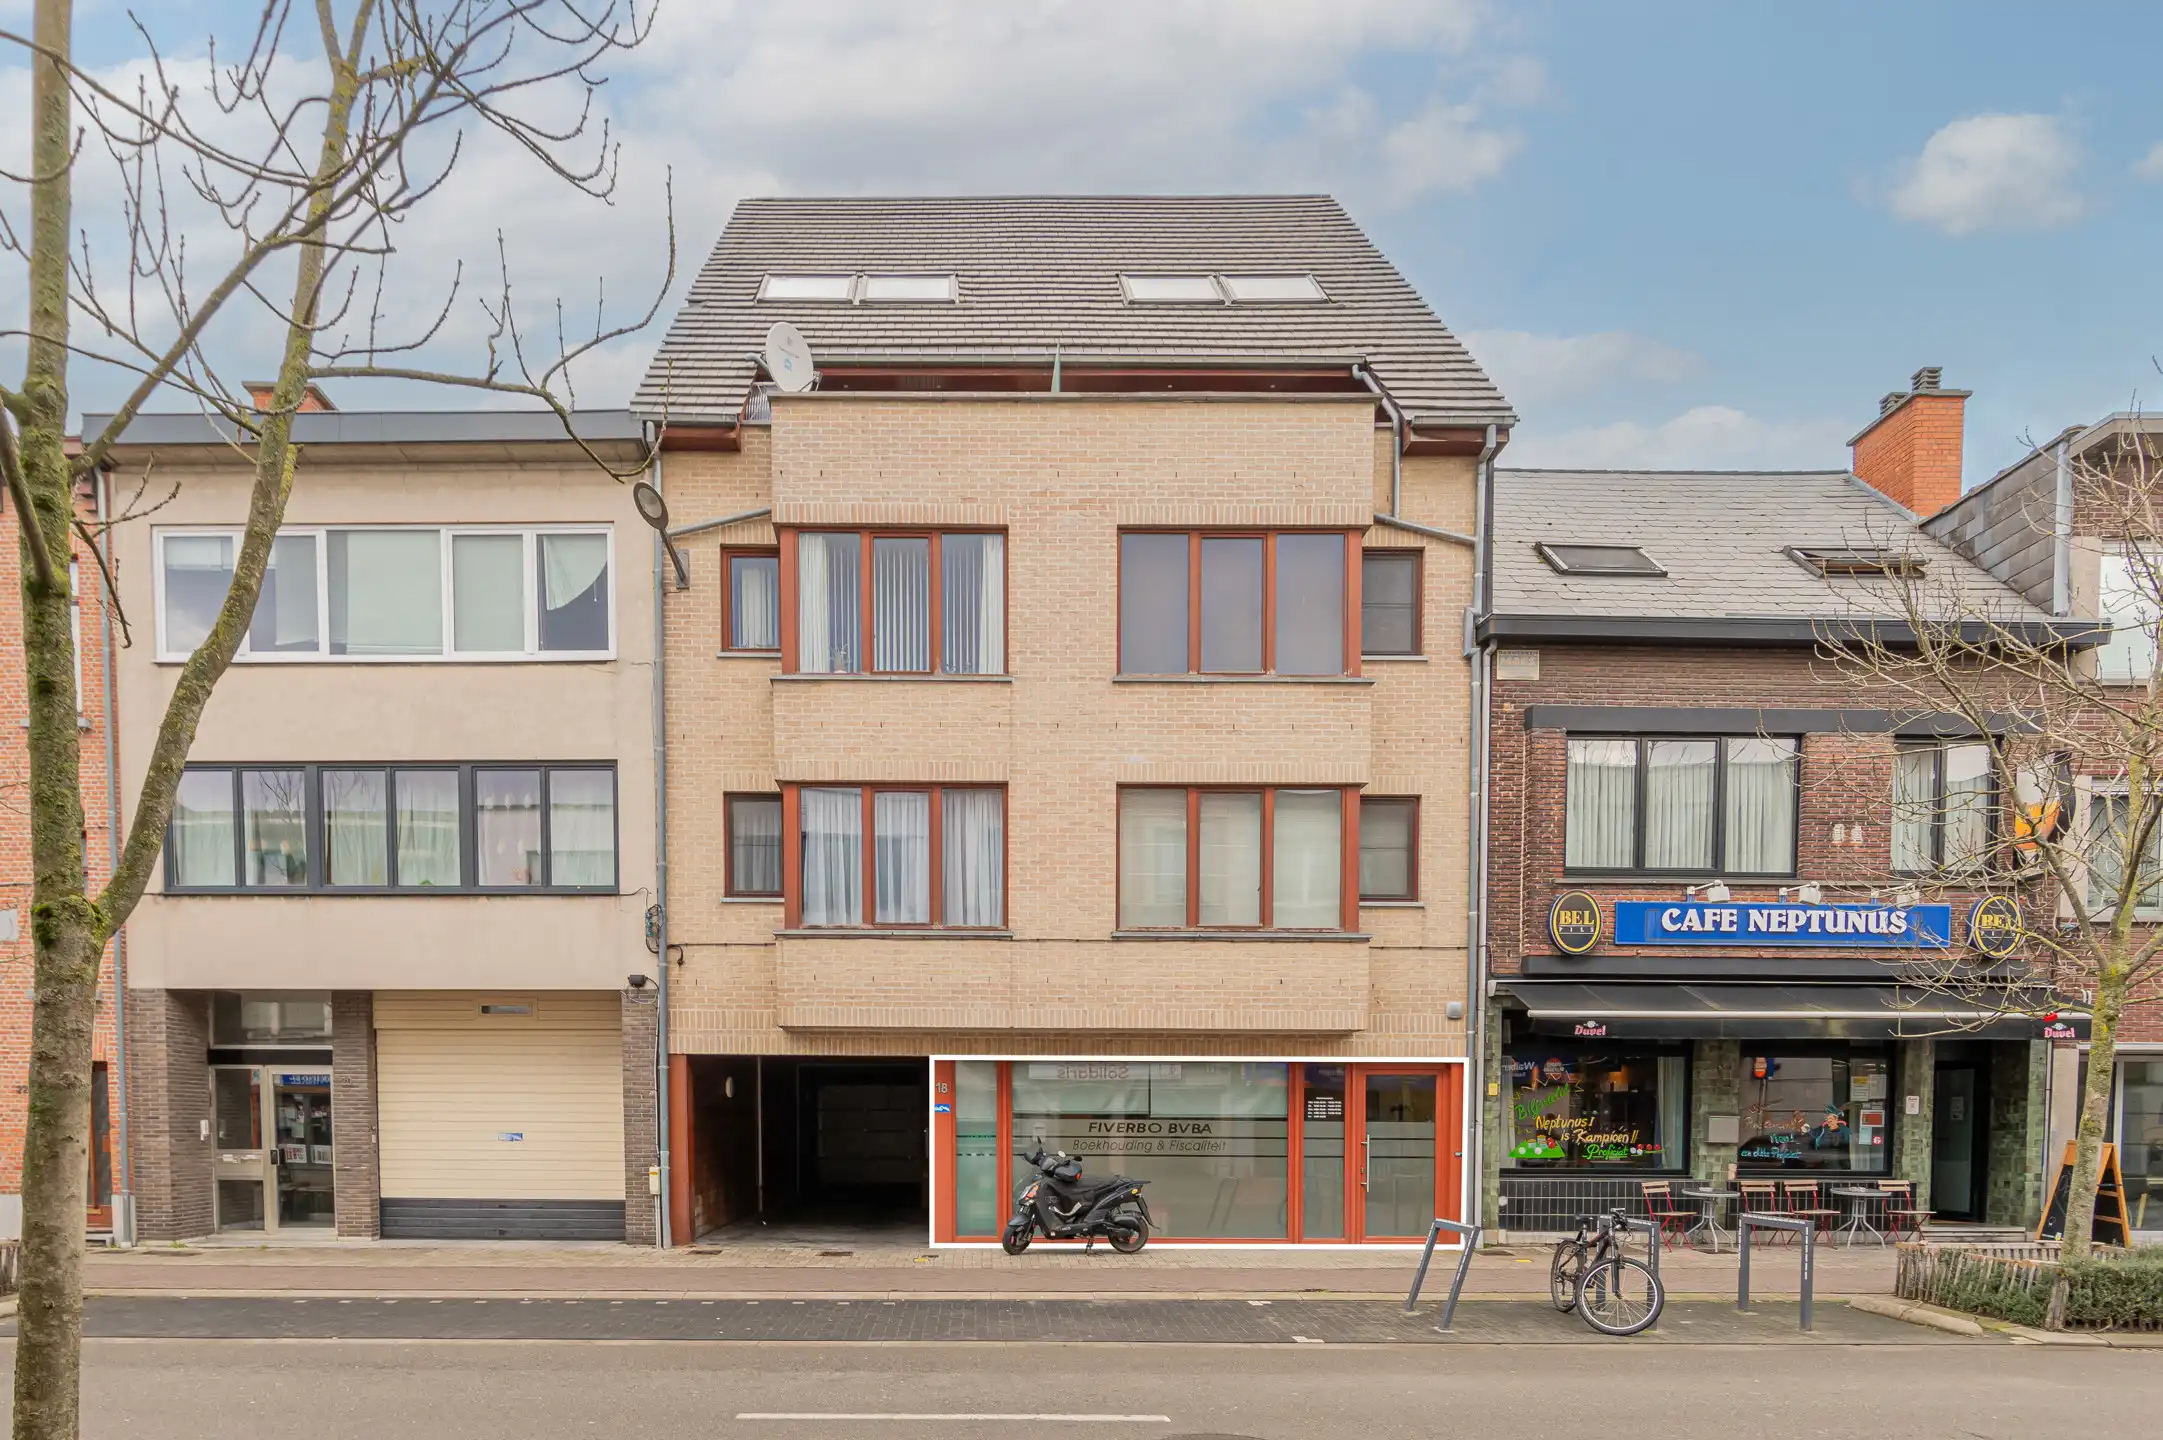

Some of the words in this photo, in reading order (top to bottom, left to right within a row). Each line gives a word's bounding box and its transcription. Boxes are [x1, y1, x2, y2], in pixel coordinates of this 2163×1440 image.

[1559, 910, 1595, 925] BEL
[1661, 908, 1738, 932] CAFE
[1748, 909, 1908, 934] NEPTUNUS
[1574, 1024, 1606, 1036] Duvel
[2044, 1026, 2075, 1038] Duvel
[936, 1082, 948, 1094] 18
[1088, 1122, 1162, 1134] FIVERBO
[1168, 1123, 1212, 1134] BVBA
[1535, 1115, 1588, 1135] Neptunus
[1560, 1129, 1570, 1141] is
[1073, 1139, 1153, 1153] Boekhouding
[1157, 1140, 1165, 1150] &
[1169, 1139, 1227, 1151] Fiscaliteit
[1584, 1143, 1629, 1160] Proficiat
